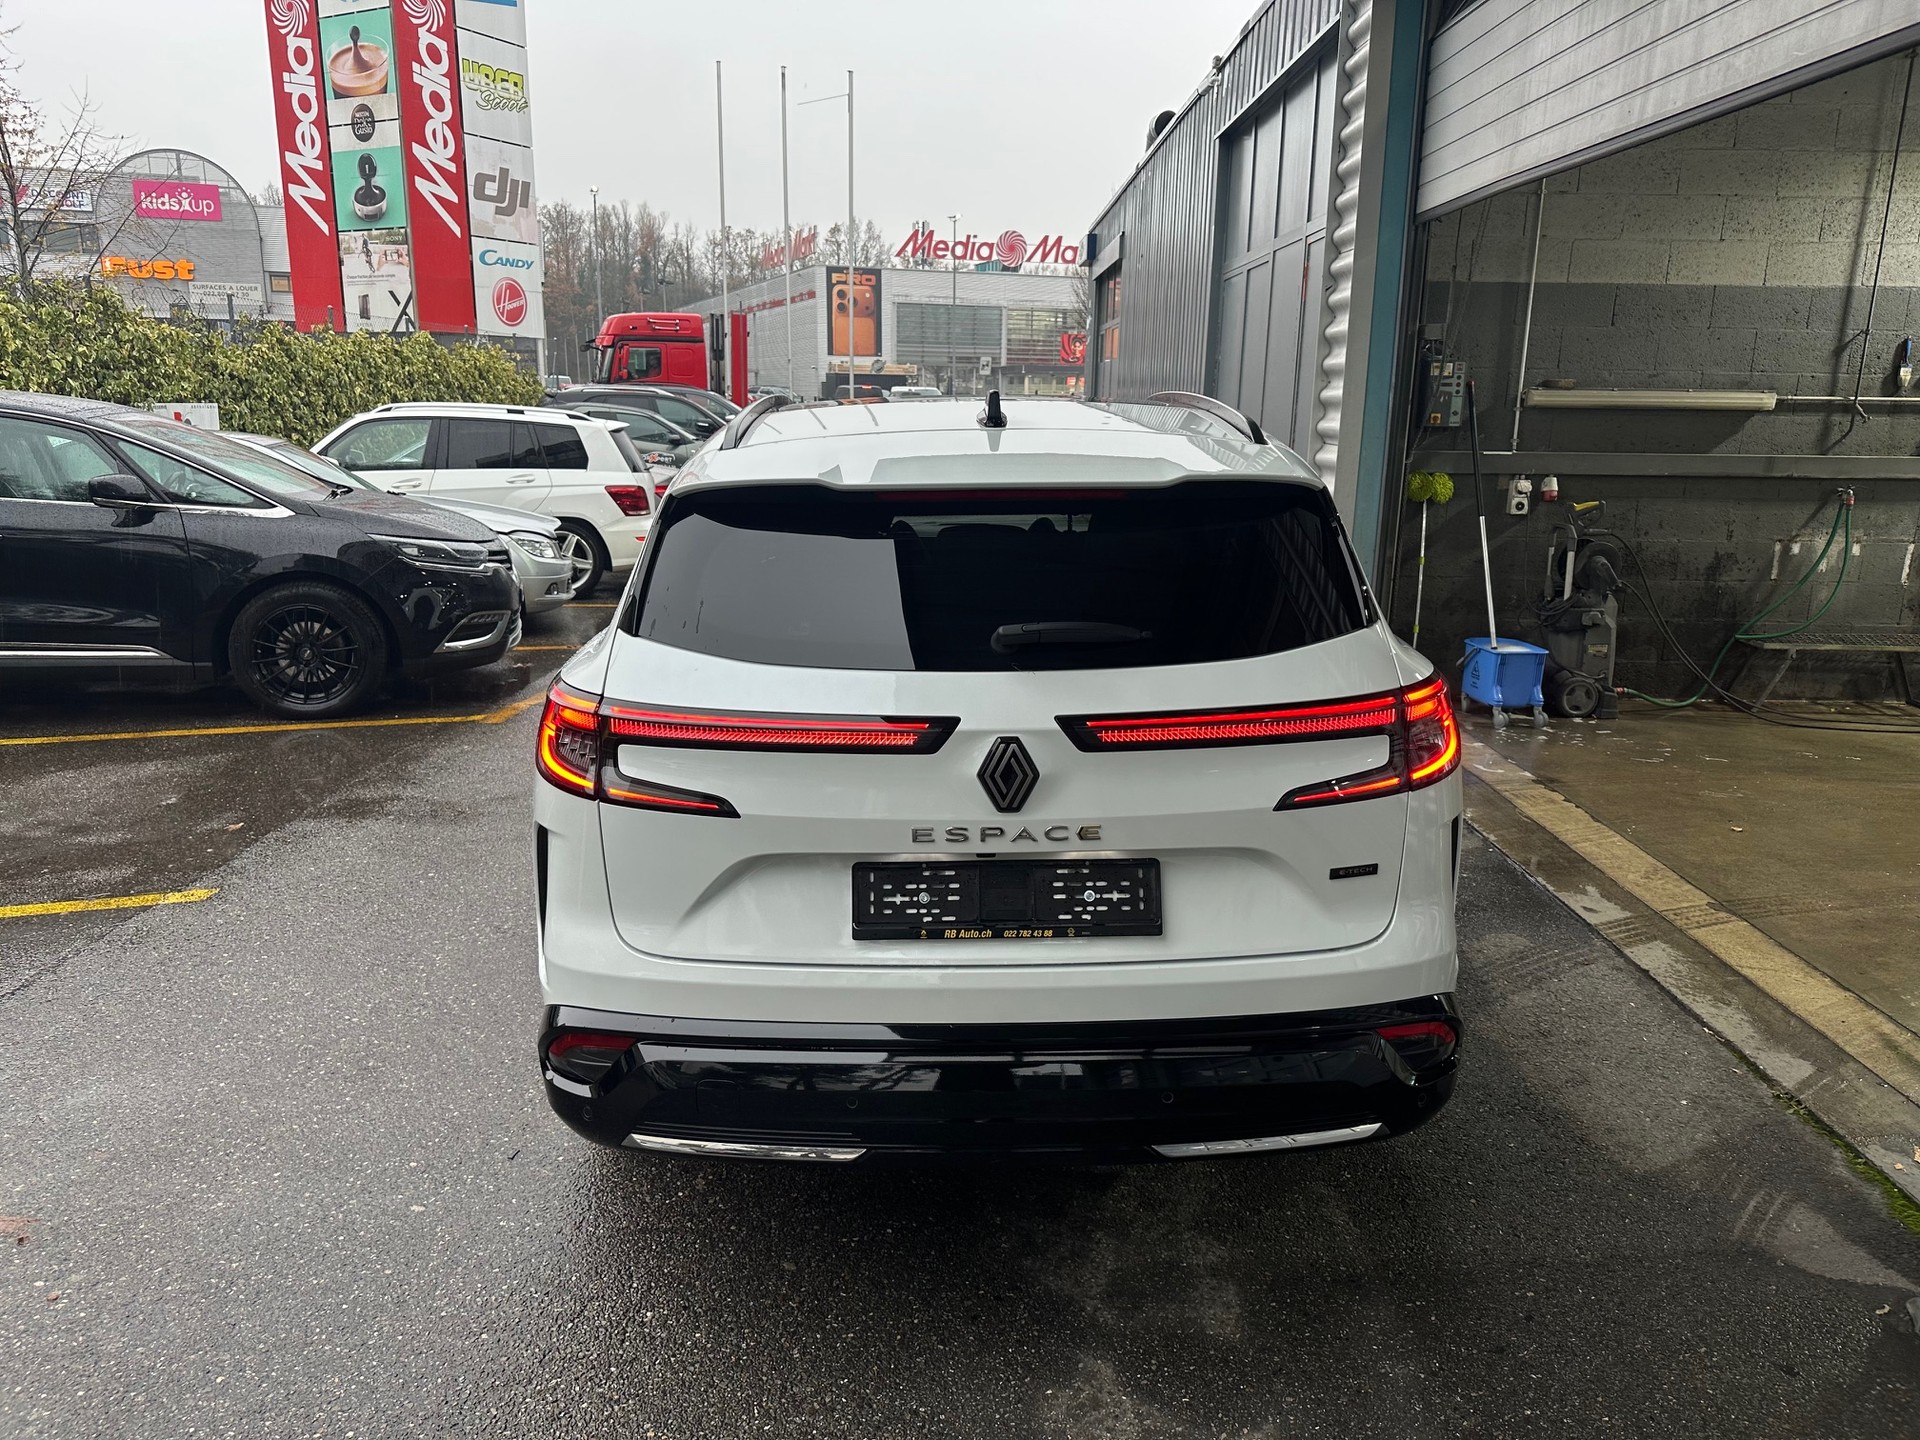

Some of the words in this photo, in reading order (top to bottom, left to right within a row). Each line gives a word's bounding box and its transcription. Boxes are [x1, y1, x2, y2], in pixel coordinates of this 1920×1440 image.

[461, 57, 525, 98] UBER
[475, 89, 529, 114] Scoot
[282, 35, 330, 237] Media
[411, 26, 461, 239] Media
[31, 188, 85, 200] DSCOUNT
[479, 249, 535, 270] CANDY
[895, 229, 996, 261] Media
[1026, 234, 1080, 265] Ma
[101, 255, 196, 281] Fust
[831, 272, 876, 286] PRO
[911, 824, 1102, 844] ESPACE
[944, 929, 956, 938] RB
[958, 929, 992, 939] Auto.ch
